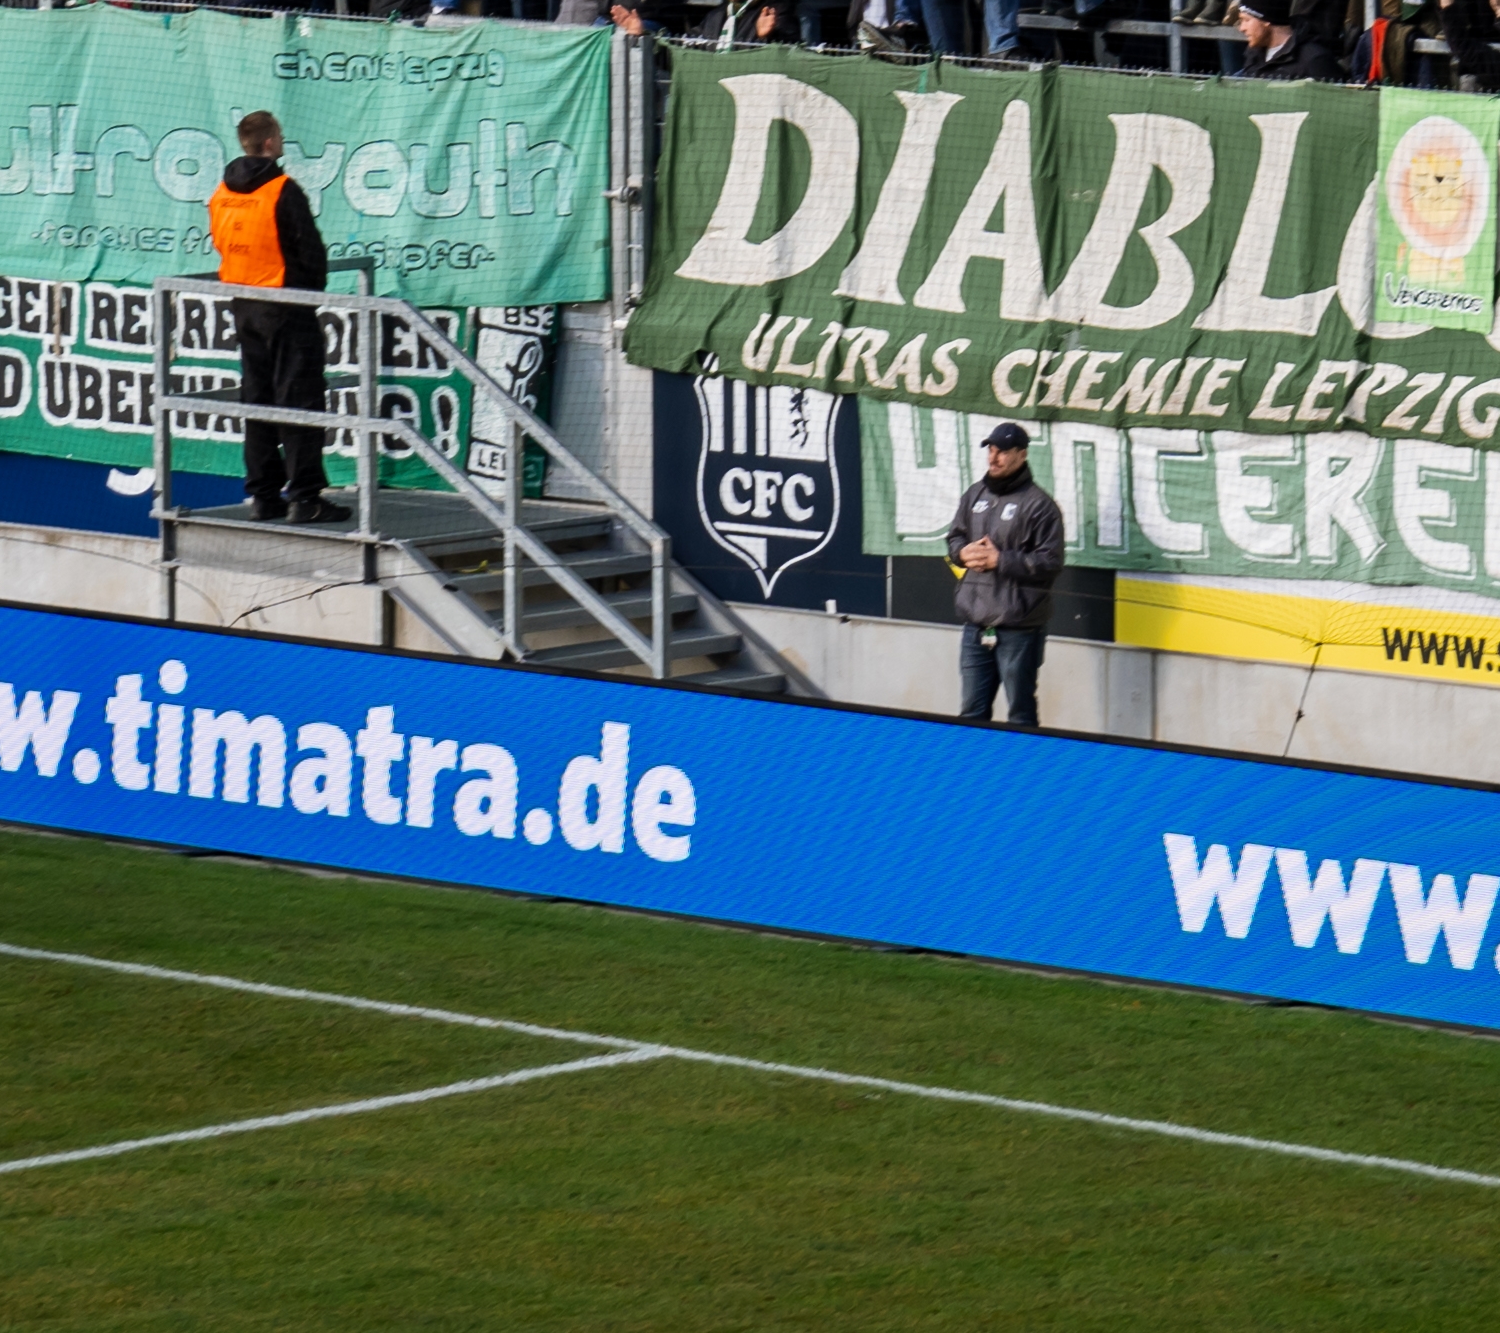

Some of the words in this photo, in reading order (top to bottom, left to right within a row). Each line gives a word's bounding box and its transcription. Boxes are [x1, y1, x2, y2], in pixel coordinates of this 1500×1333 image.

[739, 312, 972, 398] ULTRAS
[991, 345, 1247, 417] CHEMIE
[718, 466, 816, 523] CFC
